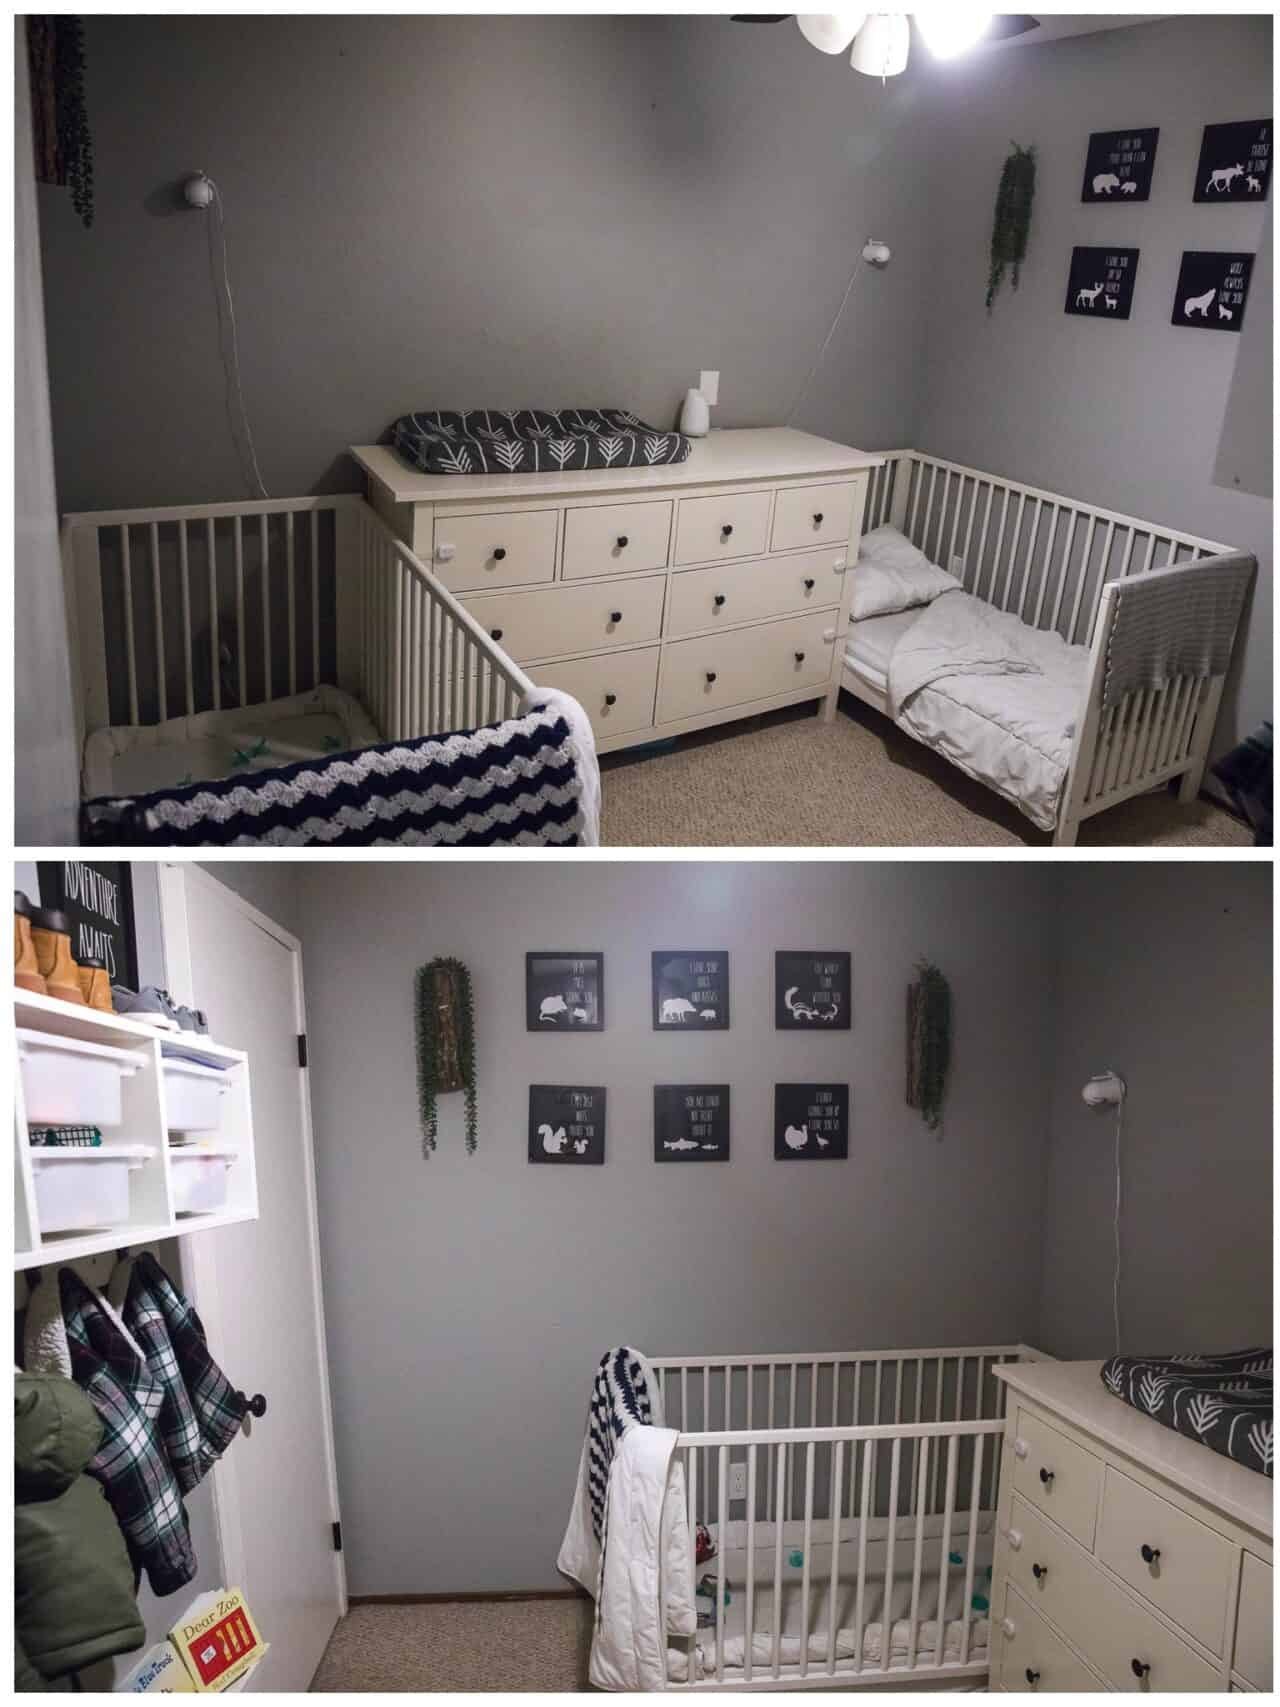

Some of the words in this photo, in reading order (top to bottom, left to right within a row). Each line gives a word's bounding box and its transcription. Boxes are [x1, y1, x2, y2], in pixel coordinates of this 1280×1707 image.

[65, 861, 120, 926] ADVENTURE
[79, 921, 117, 978] AWAITS
[183, 1611, 215, 1641] Dear
[216, 1594, 240, 1616] Zoo
